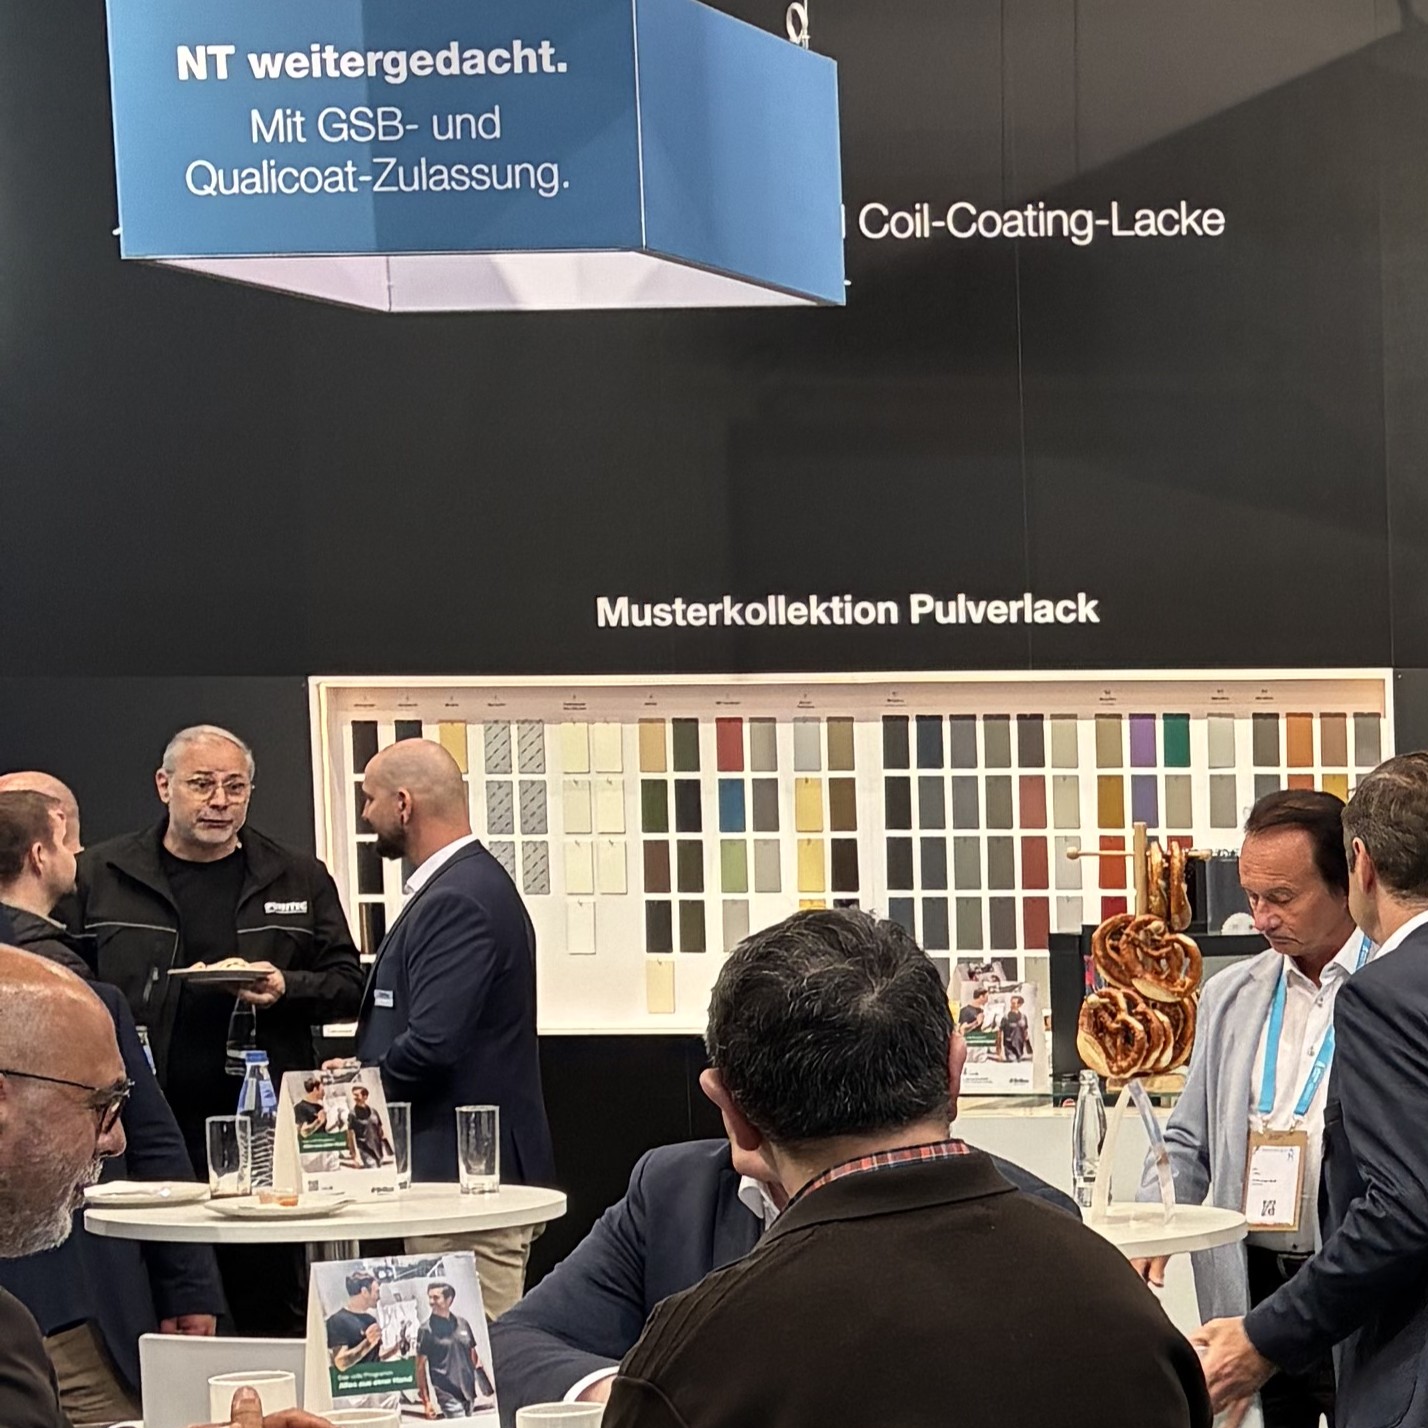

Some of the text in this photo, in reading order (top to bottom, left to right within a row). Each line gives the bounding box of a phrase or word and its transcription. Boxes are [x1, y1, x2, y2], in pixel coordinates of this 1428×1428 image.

[176, 39, 569, 84] NT weitergedacht.
[250, 104, 502, 144] Mit GSB- und
[185, 155, 571, 198] Qualicoat-Zulassung.
[858, 200, 1226, 246] Coil-Coating-Lacke
[596, 592, 1101, 628] Musterkollektion Pulverlack
